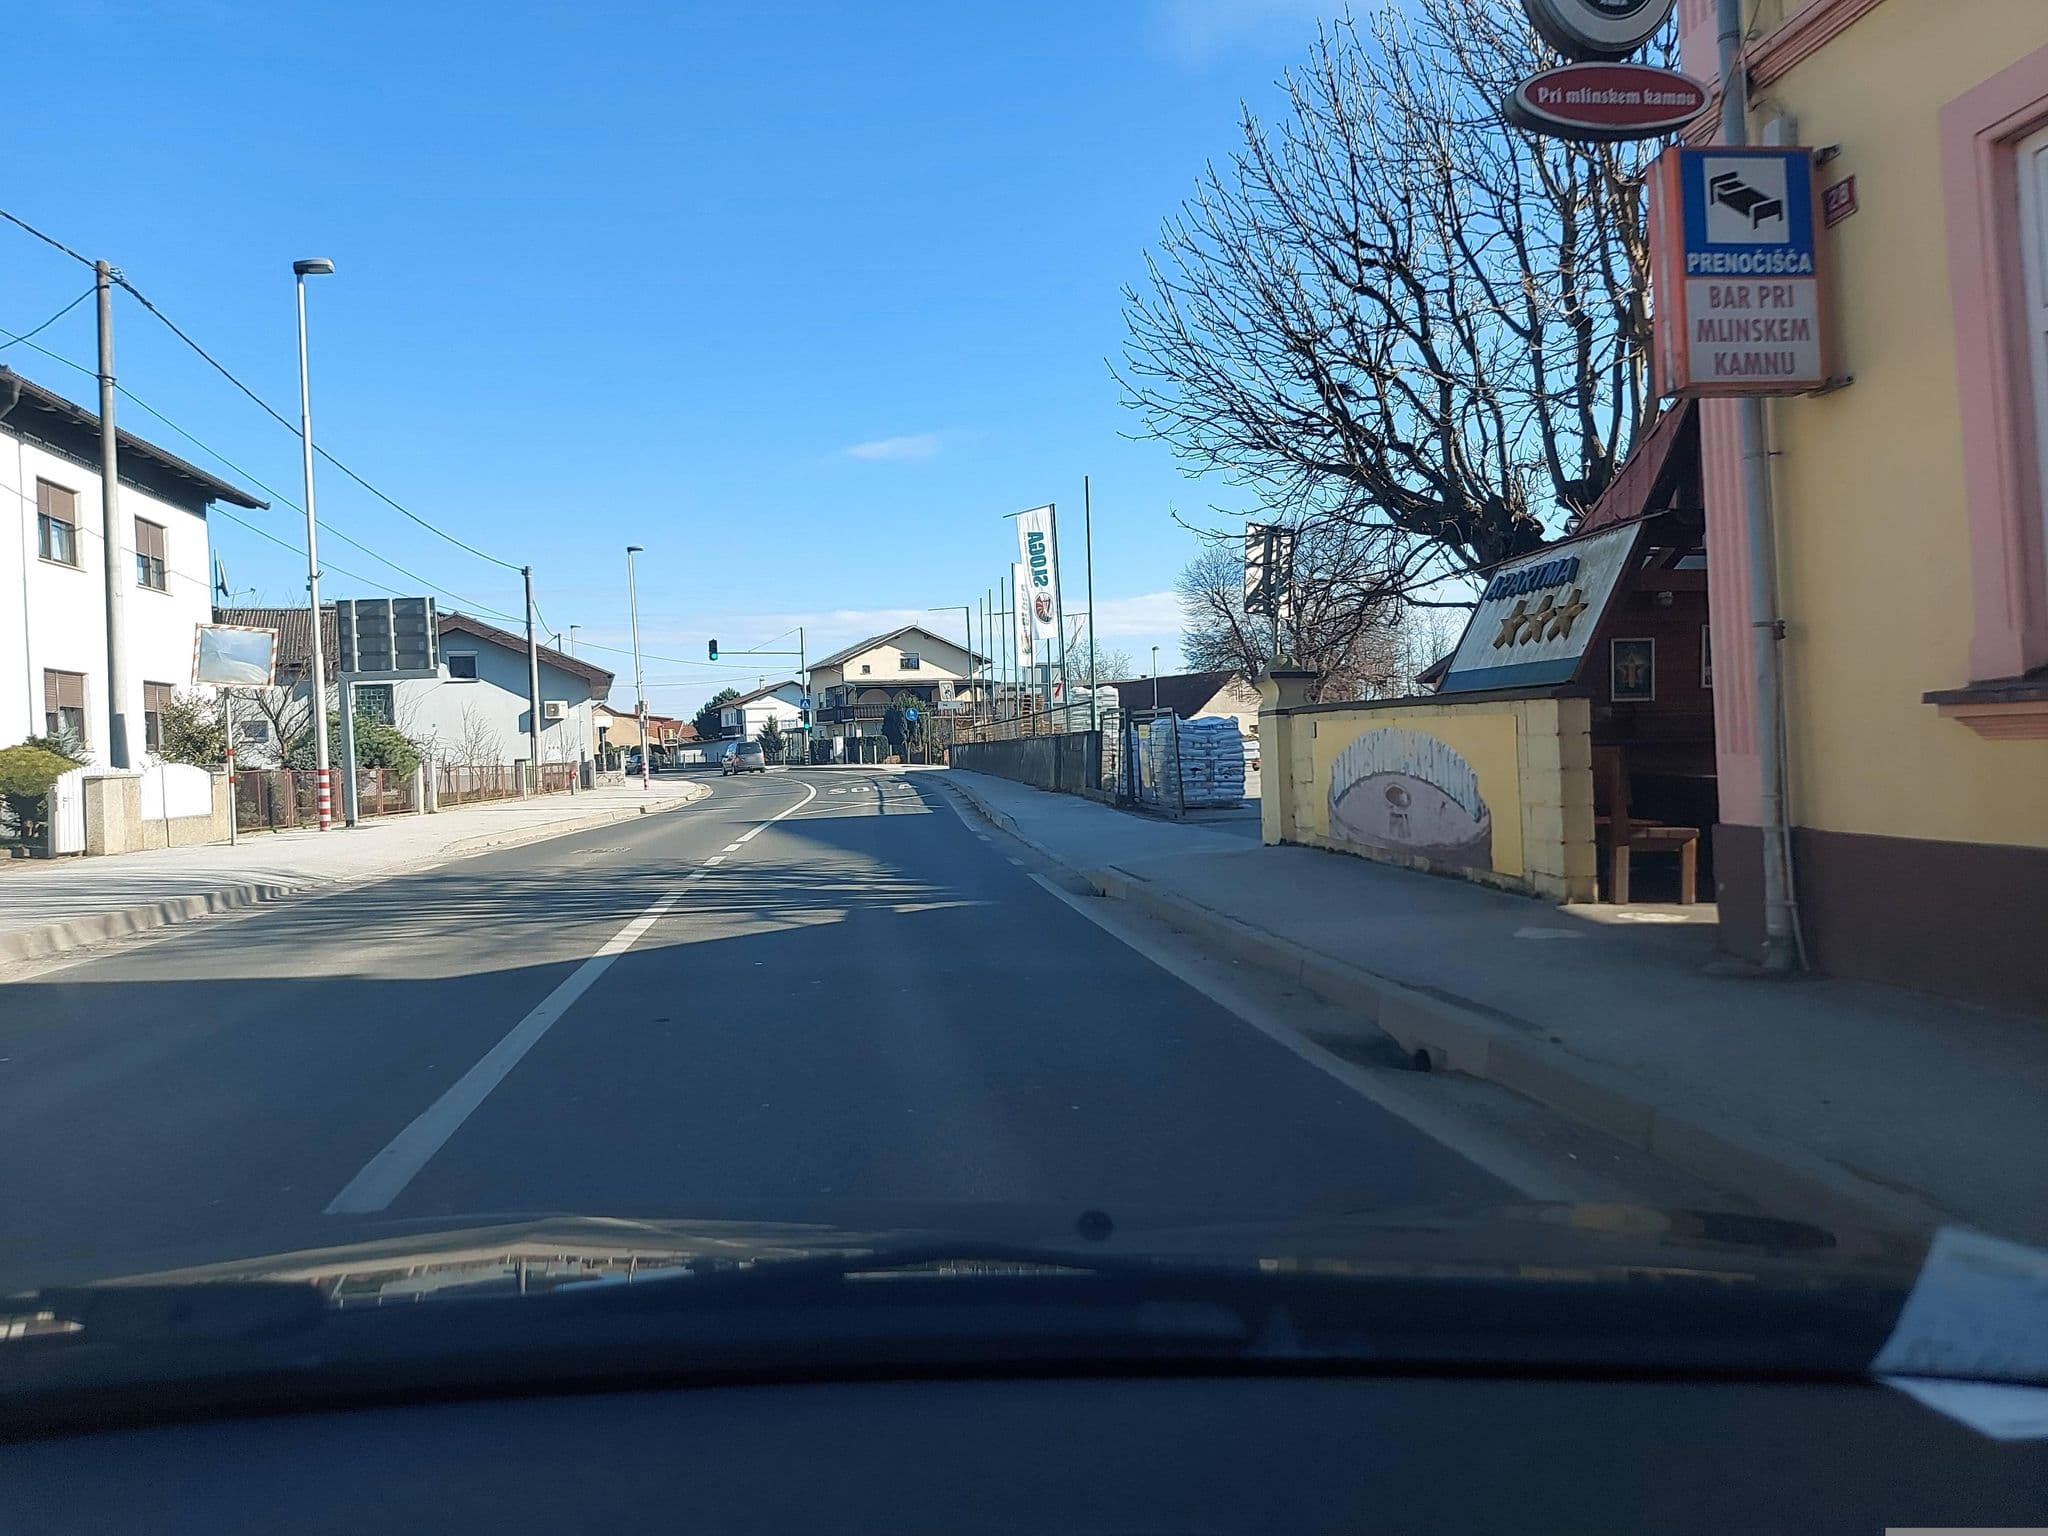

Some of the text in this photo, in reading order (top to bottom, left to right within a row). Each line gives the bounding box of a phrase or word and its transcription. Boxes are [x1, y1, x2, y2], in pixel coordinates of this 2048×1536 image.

[1537, 86, 1697, 106] Pri mlinskem kamnu
[1709, 285, 1795, 309] BAR PRI
[1696, 318, 1811, 342] MLINSKEM
[1714, 352, 1796, 375] KAMNU
[1486, 557, 1578, 600] APARTMA
